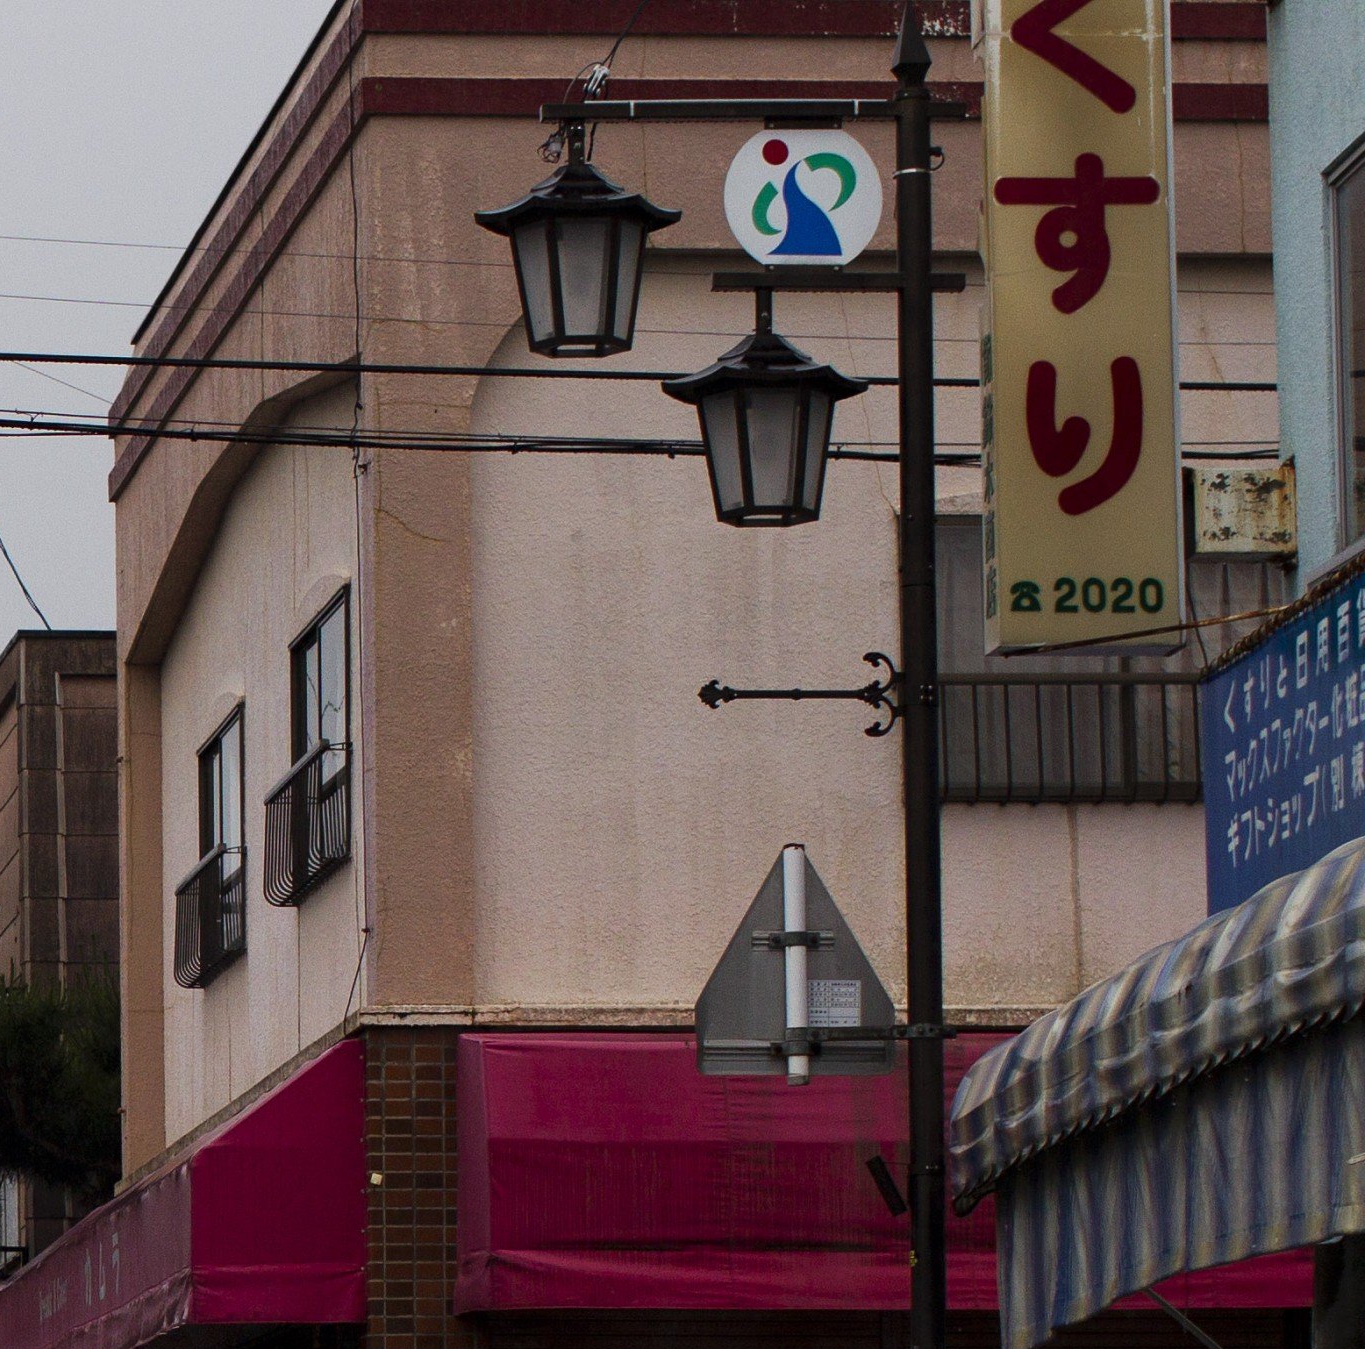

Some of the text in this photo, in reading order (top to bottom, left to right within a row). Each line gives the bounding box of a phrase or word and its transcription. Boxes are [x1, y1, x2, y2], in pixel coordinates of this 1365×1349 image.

[994, 0, 1160, 517] くすり
[1054, 577, 1164, 613] 2020
